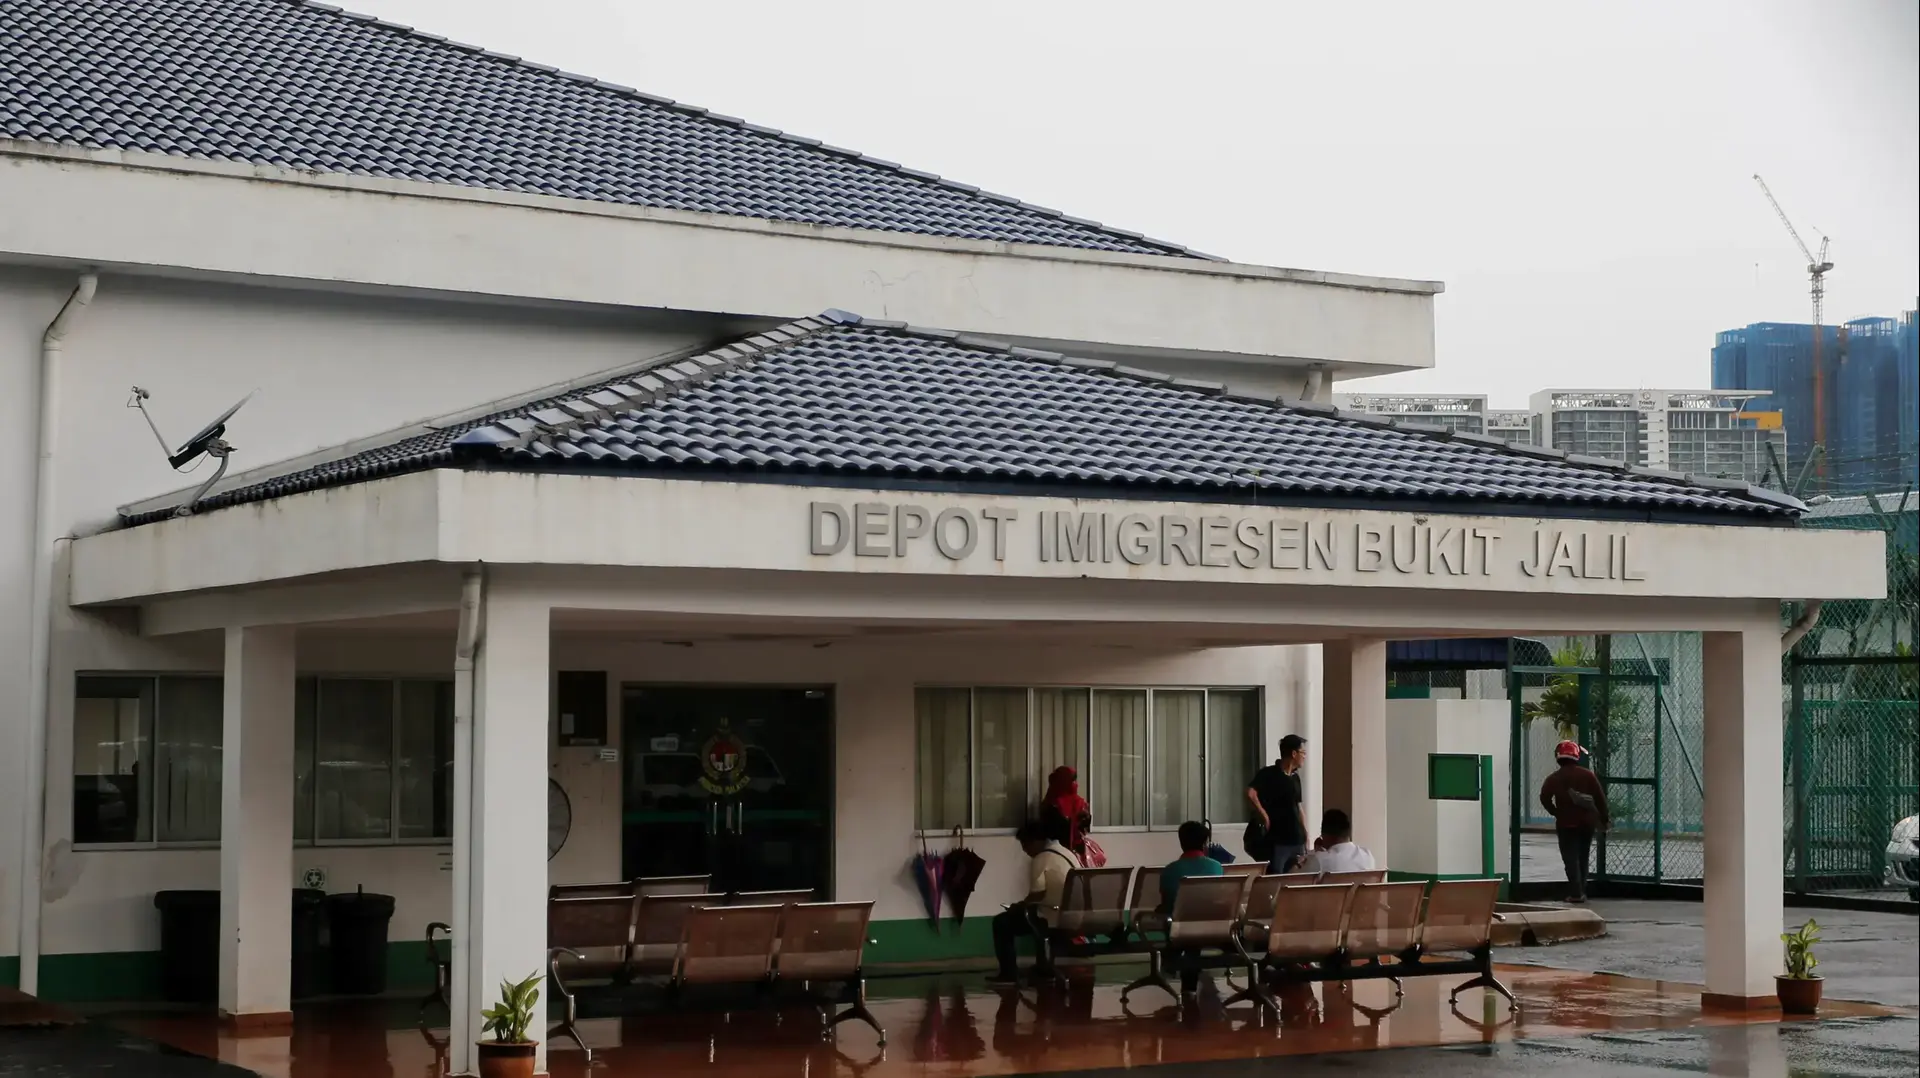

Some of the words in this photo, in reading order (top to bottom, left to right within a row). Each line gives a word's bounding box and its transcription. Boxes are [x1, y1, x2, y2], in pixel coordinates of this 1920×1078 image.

[810, 501, 1019, 561] DEPOT
[1039, 511, 1338, 571] IMIGRESEN
[1355, 523, 1501, 576] BUKIT
[1520, 529, 1646, 582] JALIL
